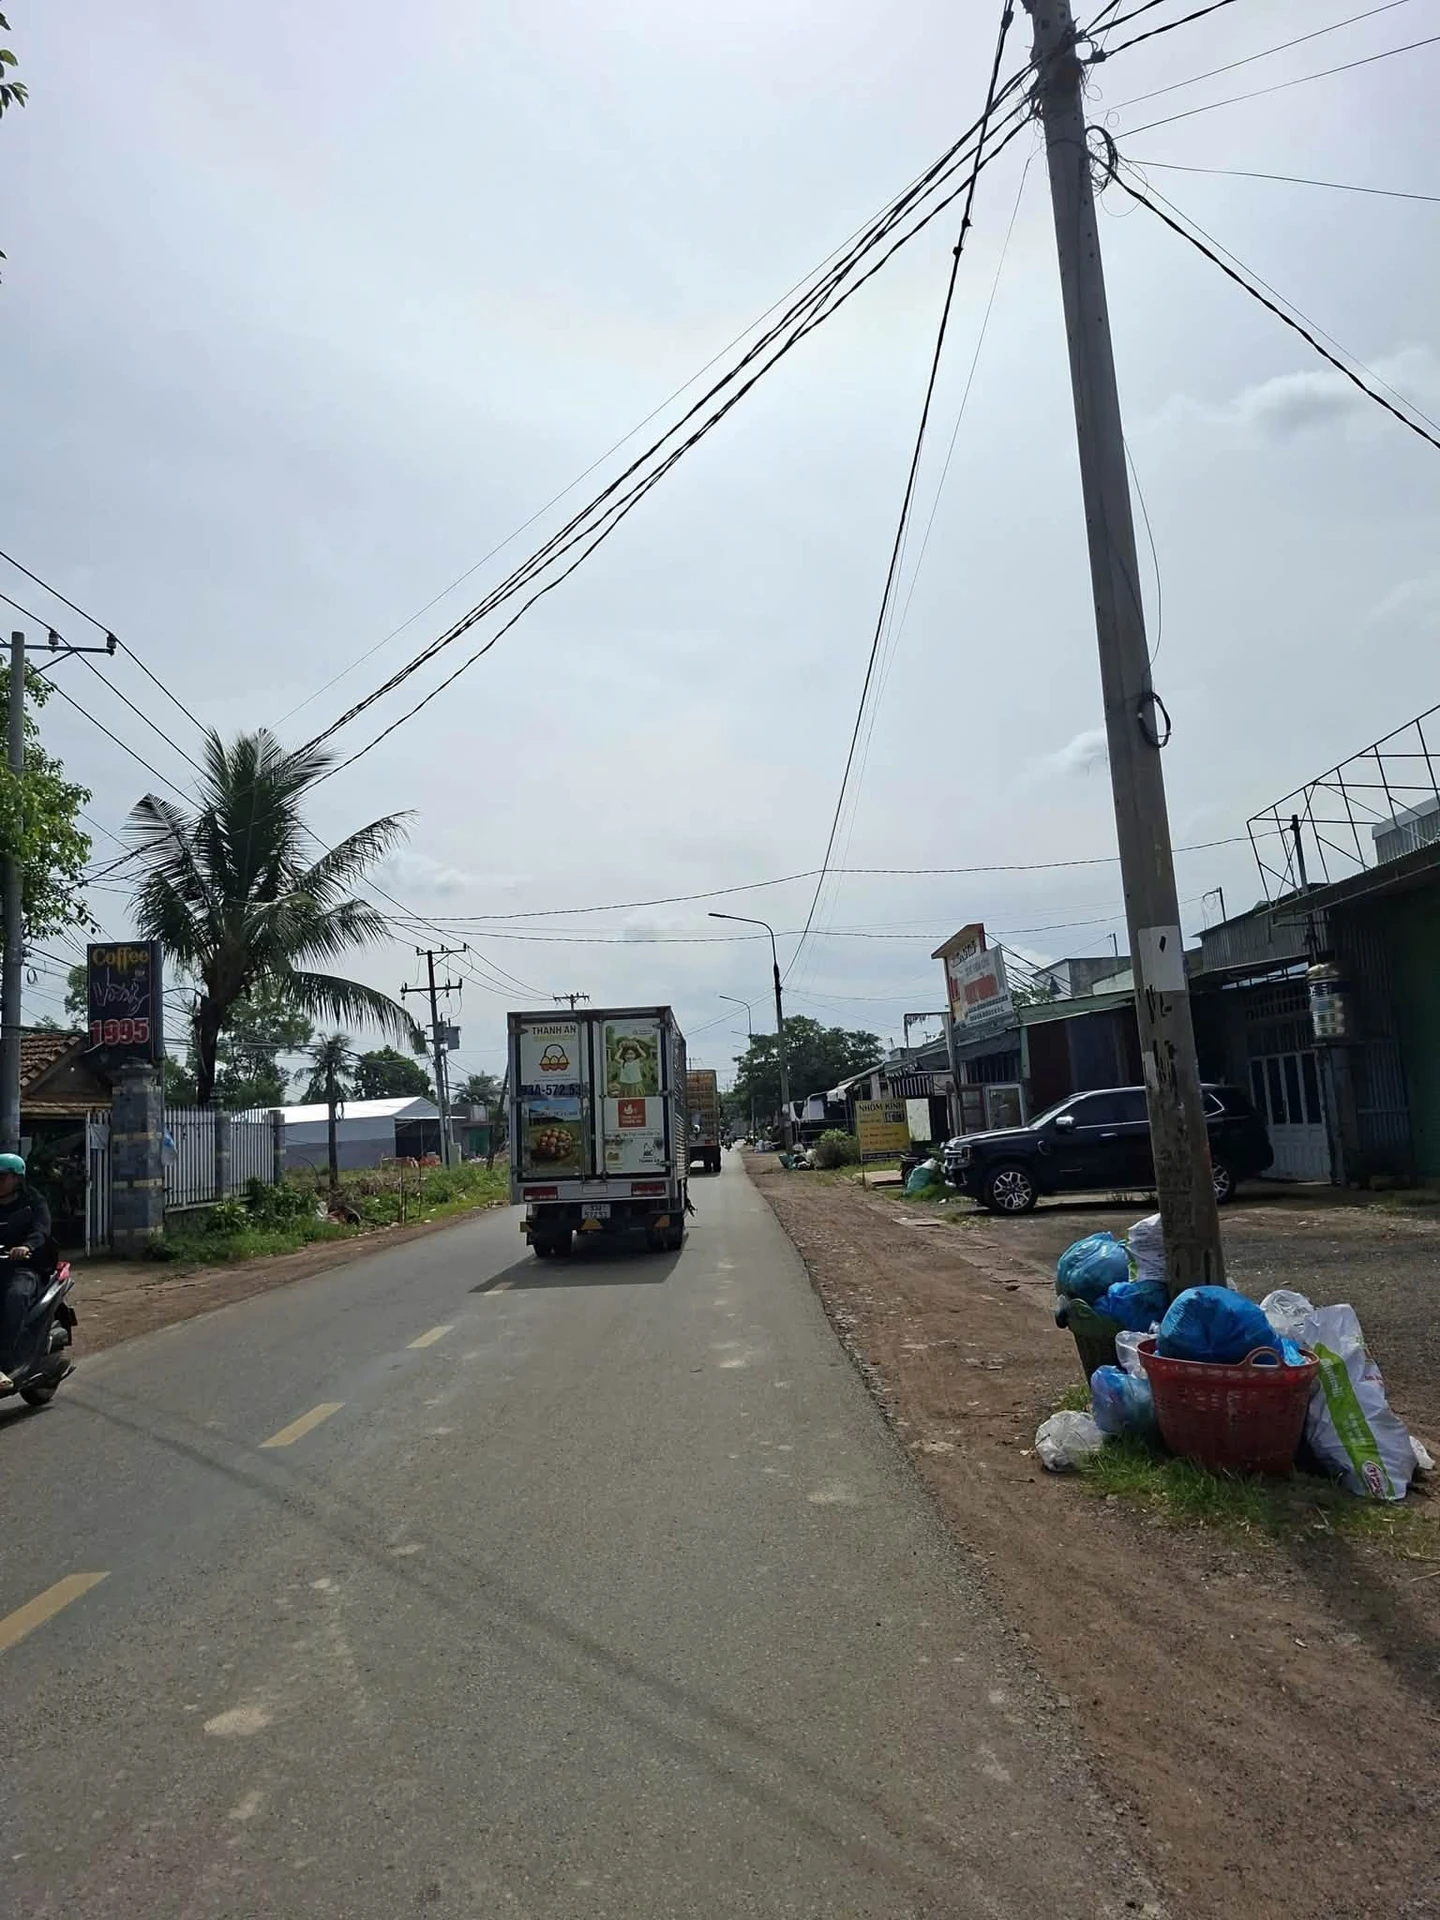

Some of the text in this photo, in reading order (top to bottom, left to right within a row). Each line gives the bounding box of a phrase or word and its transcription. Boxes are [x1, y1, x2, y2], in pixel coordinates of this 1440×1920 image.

[92, 946, 149, 974] Coffee
[89, 1017, 150, 1046] 1995
[532, 1025, 577, 1036] THANH AN
